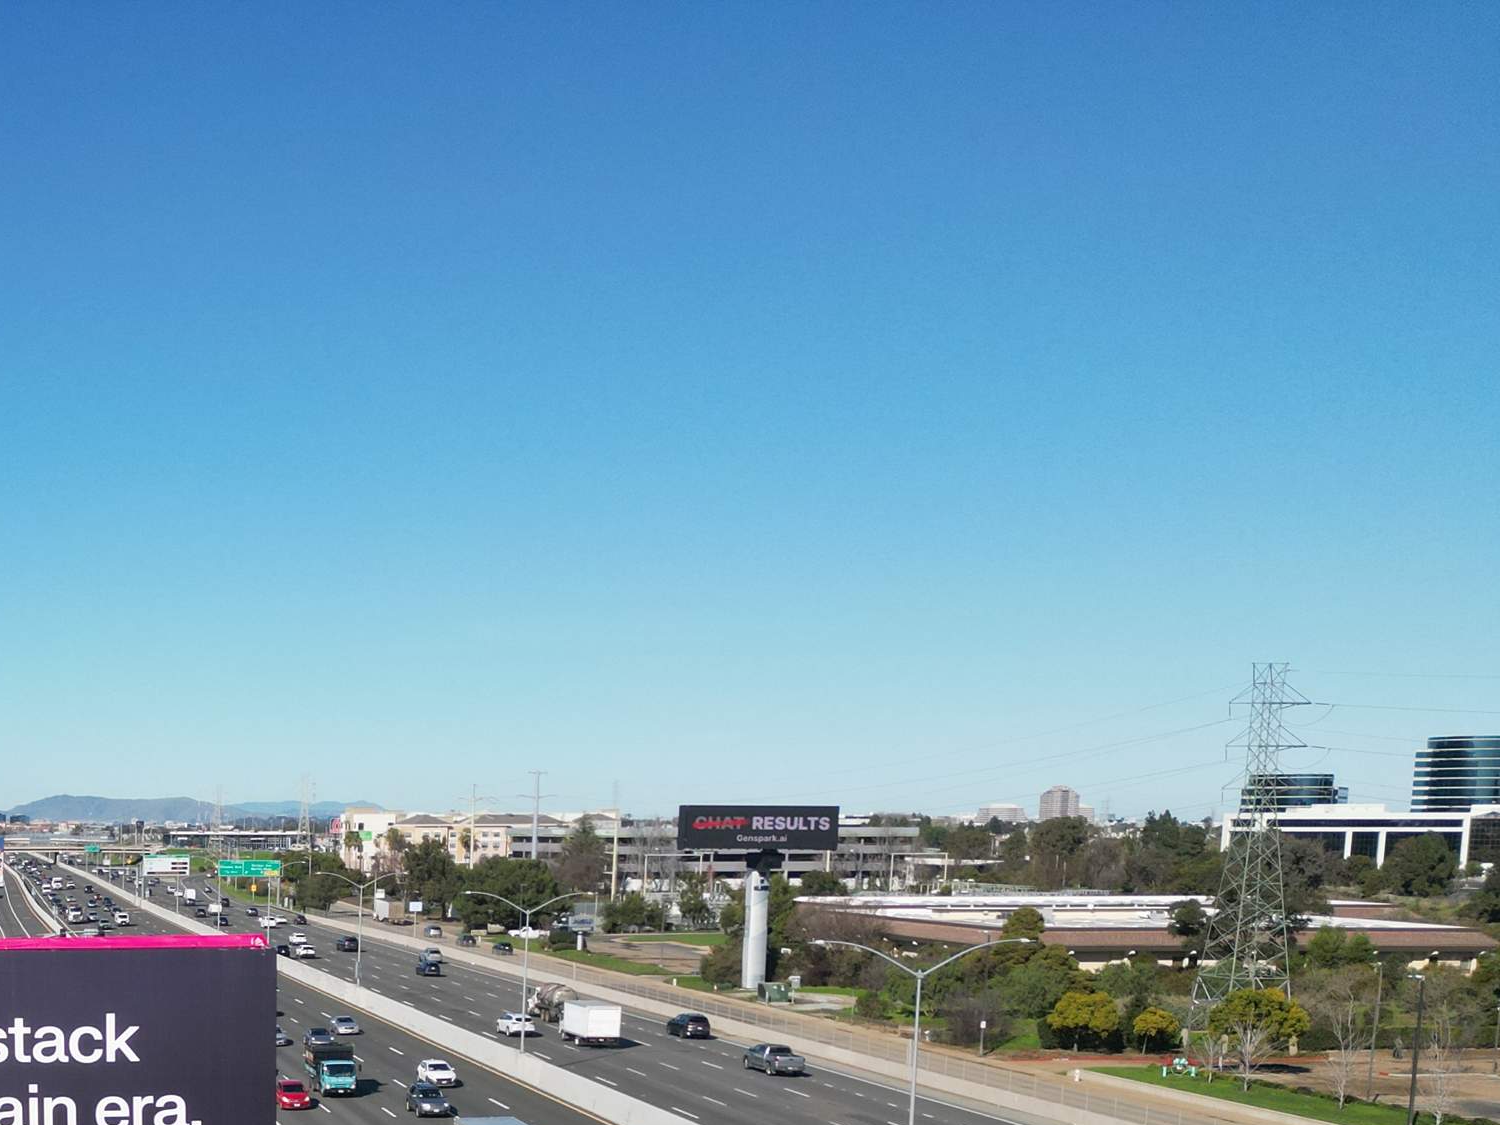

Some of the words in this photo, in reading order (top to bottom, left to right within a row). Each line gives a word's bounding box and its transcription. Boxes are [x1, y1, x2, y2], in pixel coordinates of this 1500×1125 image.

[694, 816, 746, 831] CHAT
[751, 816, 831, 831] RESULTS
[736, 834, 788, 843] Genspark.ai
